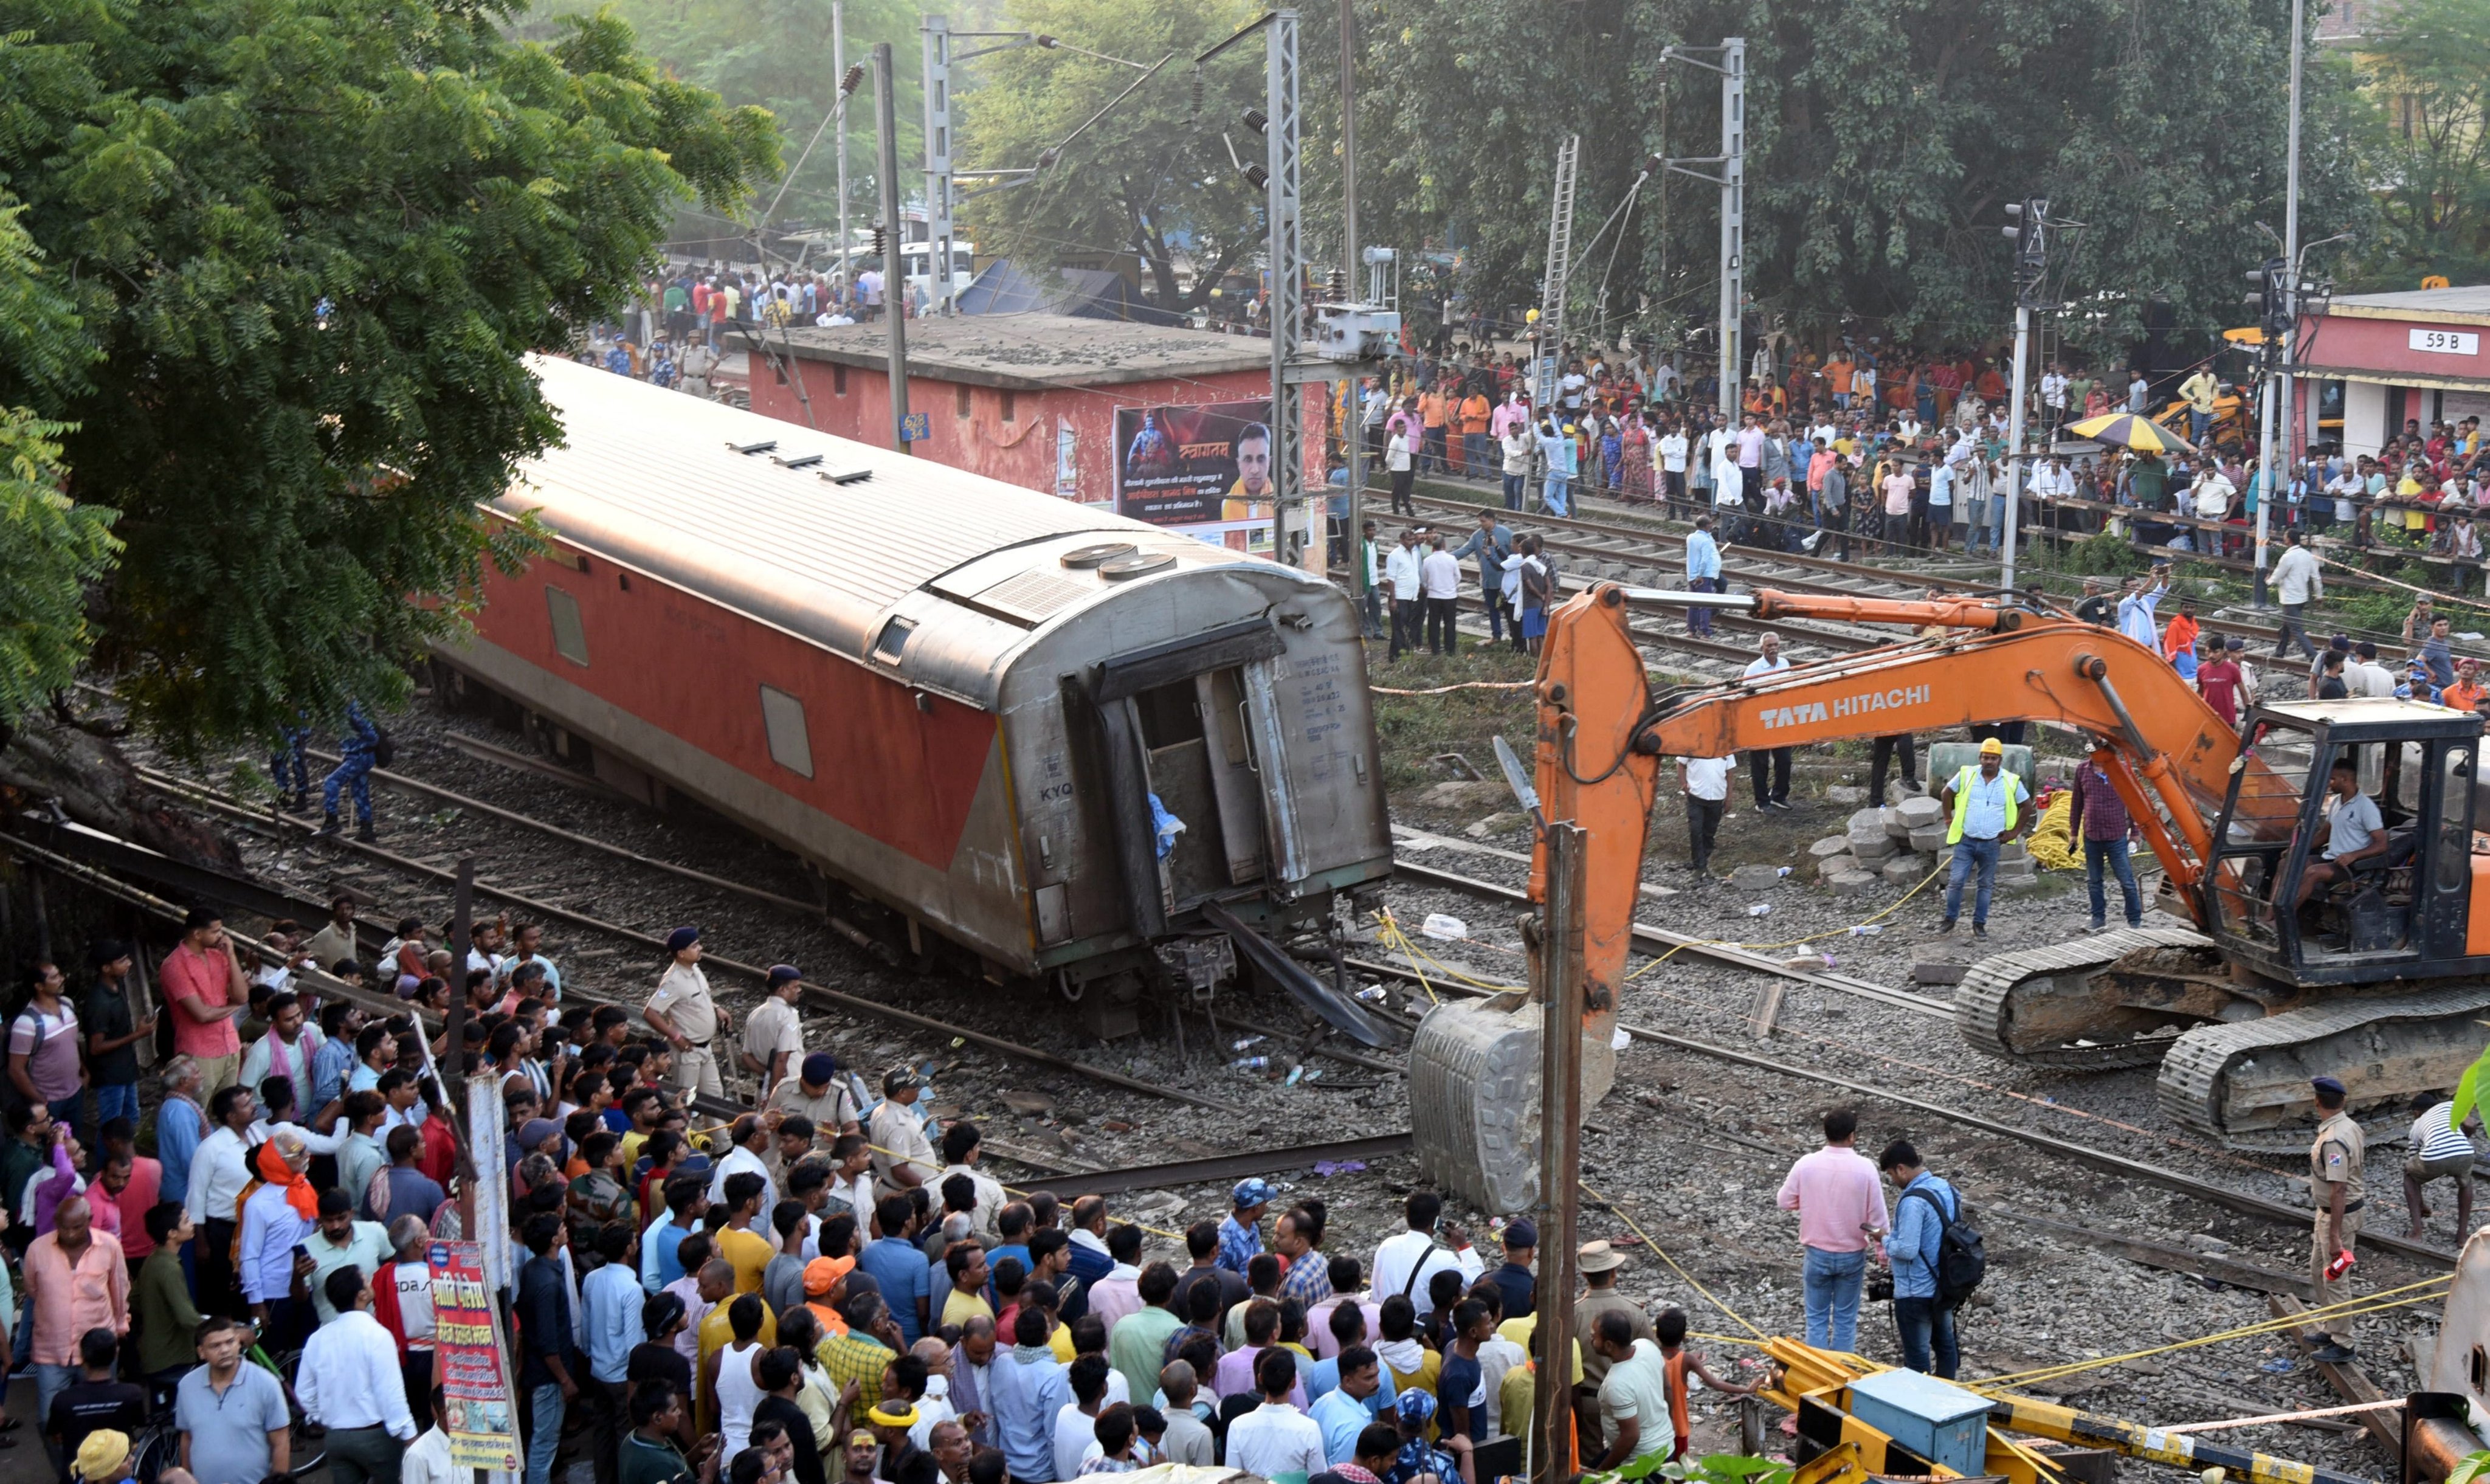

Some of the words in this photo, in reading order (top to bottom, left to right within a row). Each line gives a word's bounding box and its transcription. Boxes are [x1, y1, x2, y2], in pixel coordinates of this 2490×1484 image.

[2426, 333, 2444, 347] 59
[2450, 335, 2459, 349] B
[904, 414, 925, 427] 628
[910, 427, 923, 440] 34
[1759, 702, 1829, 730] TATA
[1833, 684, 1930, 718] HITACHI
[1040, 783, 1072, 801] KYQ
